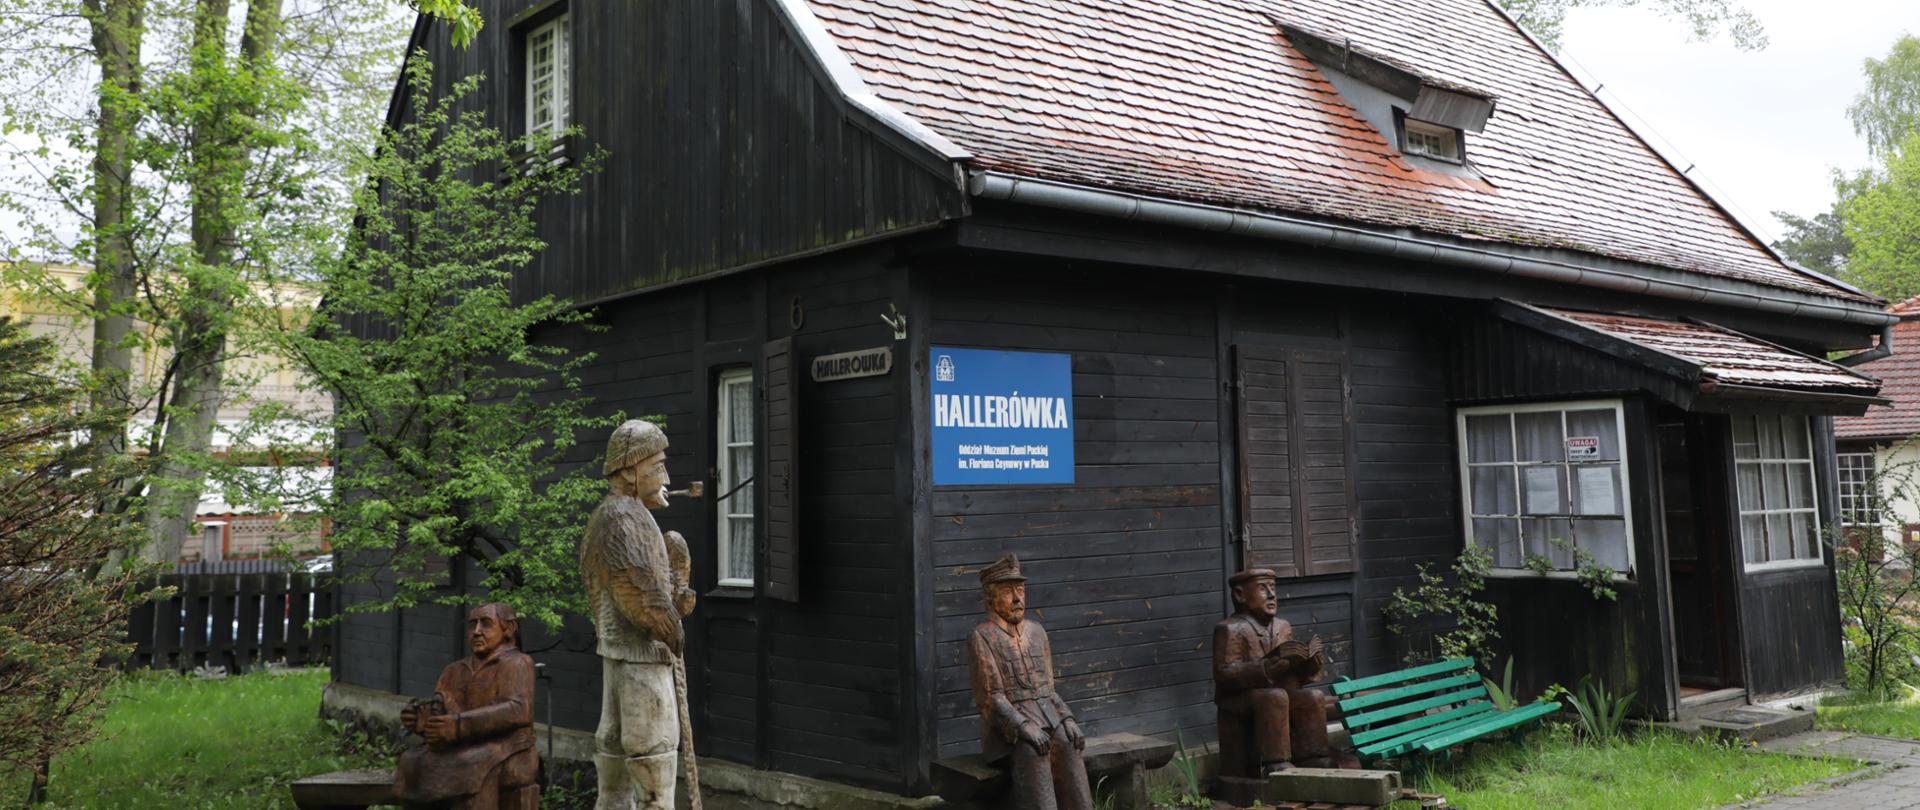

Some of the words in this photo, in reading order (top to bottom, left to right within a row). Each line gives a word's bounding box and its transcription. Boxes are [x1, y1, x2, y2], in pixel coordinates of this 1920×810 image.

[790, 296, 803, 330] 6
[934, 390, 1068, 429] HALLERÓWKA
[1570, 439, 1597, 447] UWAGA!
[958, 444, 982, 455] Oddział
[983, 444, 1009, 455] Muzeum
[1010, 445, 1026, 455] Ziemi
[1027, 445, 1049, 456] Puckiej
[958, 458, 968, 469] im.
[969, 458, 994, 469] Floriana
[1024, 460, 1031, 469] w
